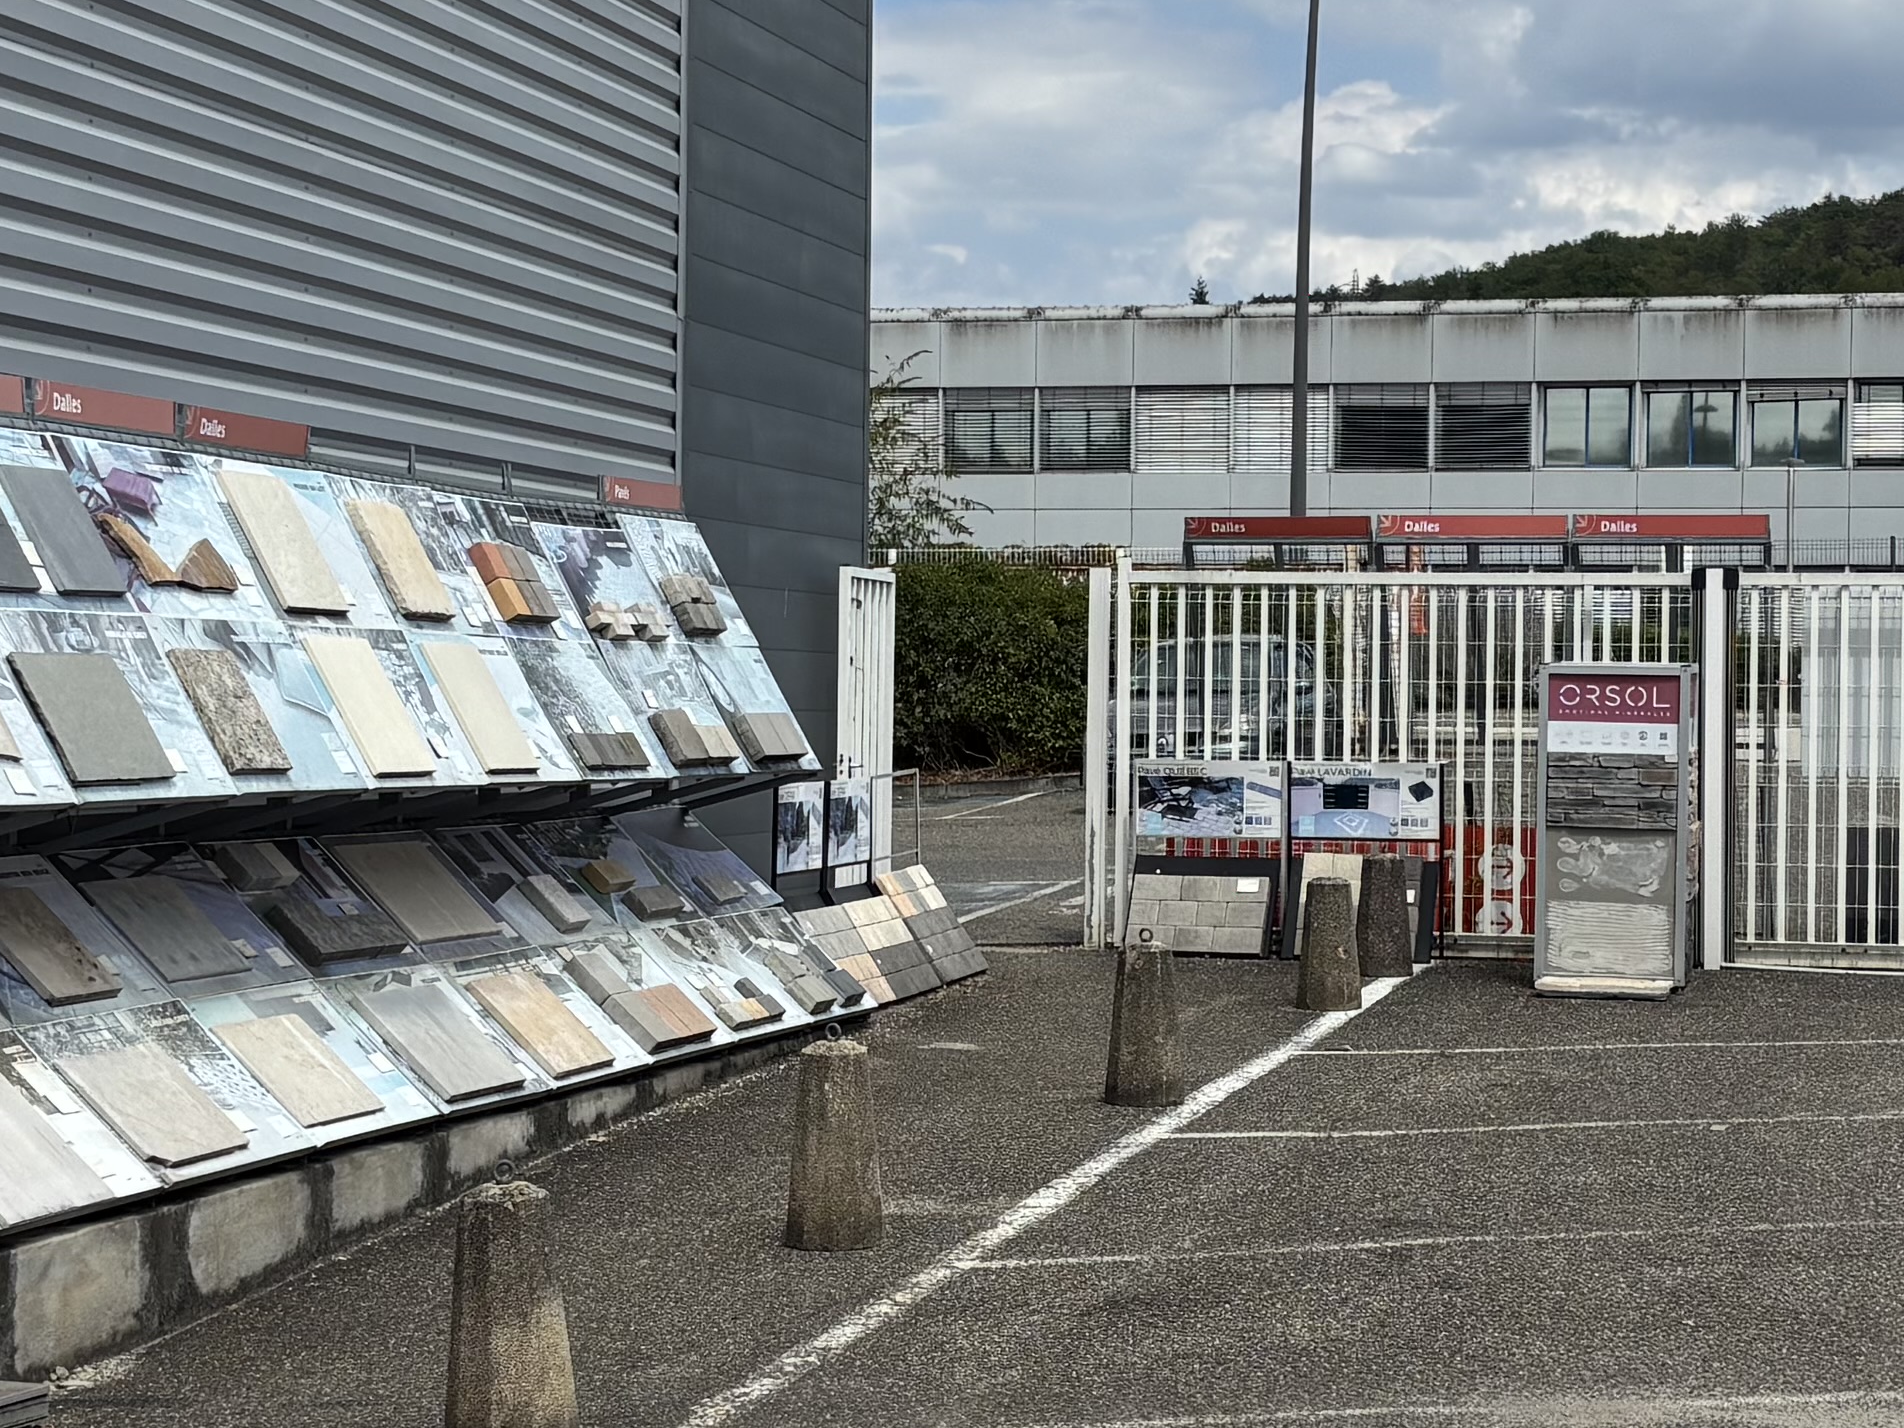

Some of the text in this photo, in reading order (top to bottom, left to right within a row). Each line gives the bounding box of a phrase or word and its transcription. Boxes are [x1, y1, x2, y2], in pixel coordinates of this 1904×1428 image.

[52, 392, 82, 414] Dalles
[199, 417, 226, 438] Dalles
[1210, 521, 1246, 533] Dalles
[1404, 520, 1440, 533] Dalles
[1600, 520, 1637, 533] Dalles
[1559, 684, 1671, 707] ORSOL
